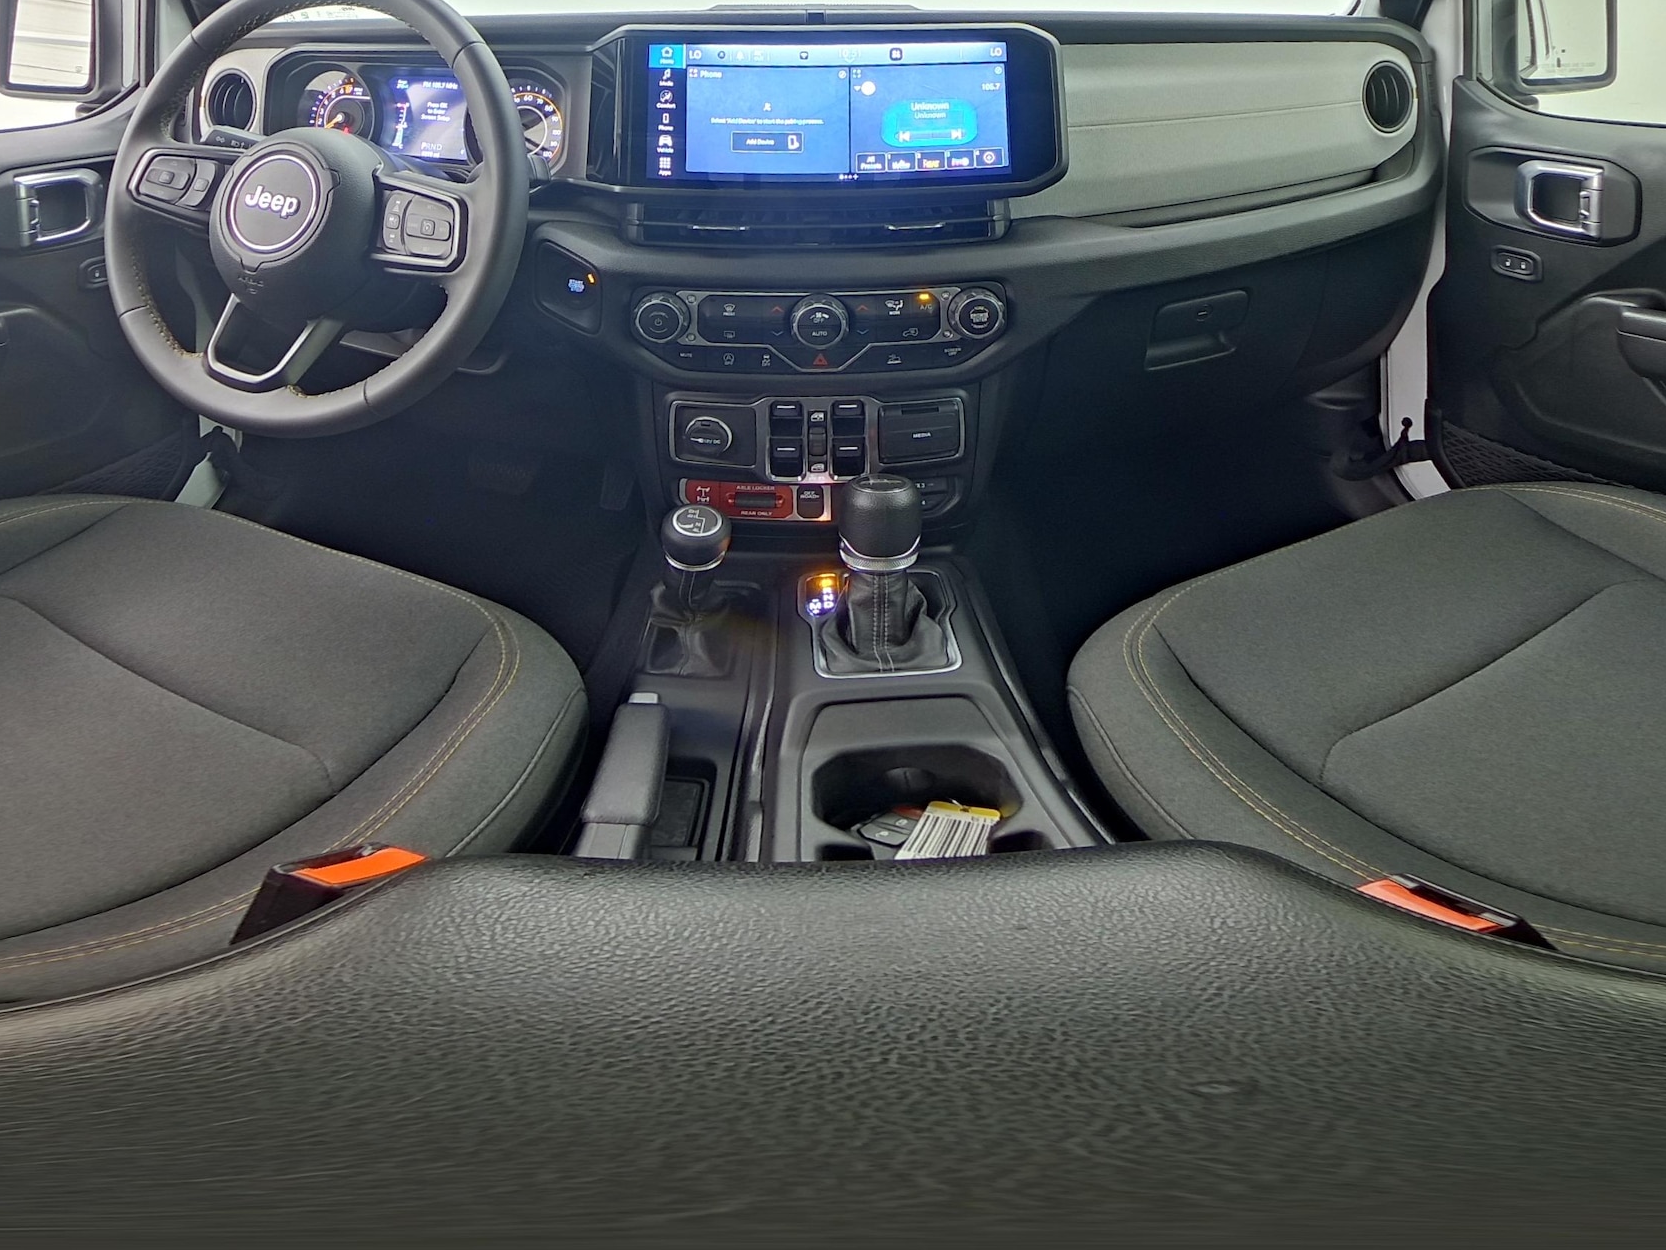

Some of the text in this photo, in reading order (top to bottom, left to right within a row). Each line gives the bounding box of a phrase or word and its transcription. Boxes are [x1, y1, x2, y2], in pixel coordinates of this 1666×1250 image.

[689, 50, 702, 60] LO
[990, 47, 1003, 57] LO
[700, 70, 722, 78] Phone
[911, 101, 950, 111] Unknown
[244, 184, 301, 219] Jeep
